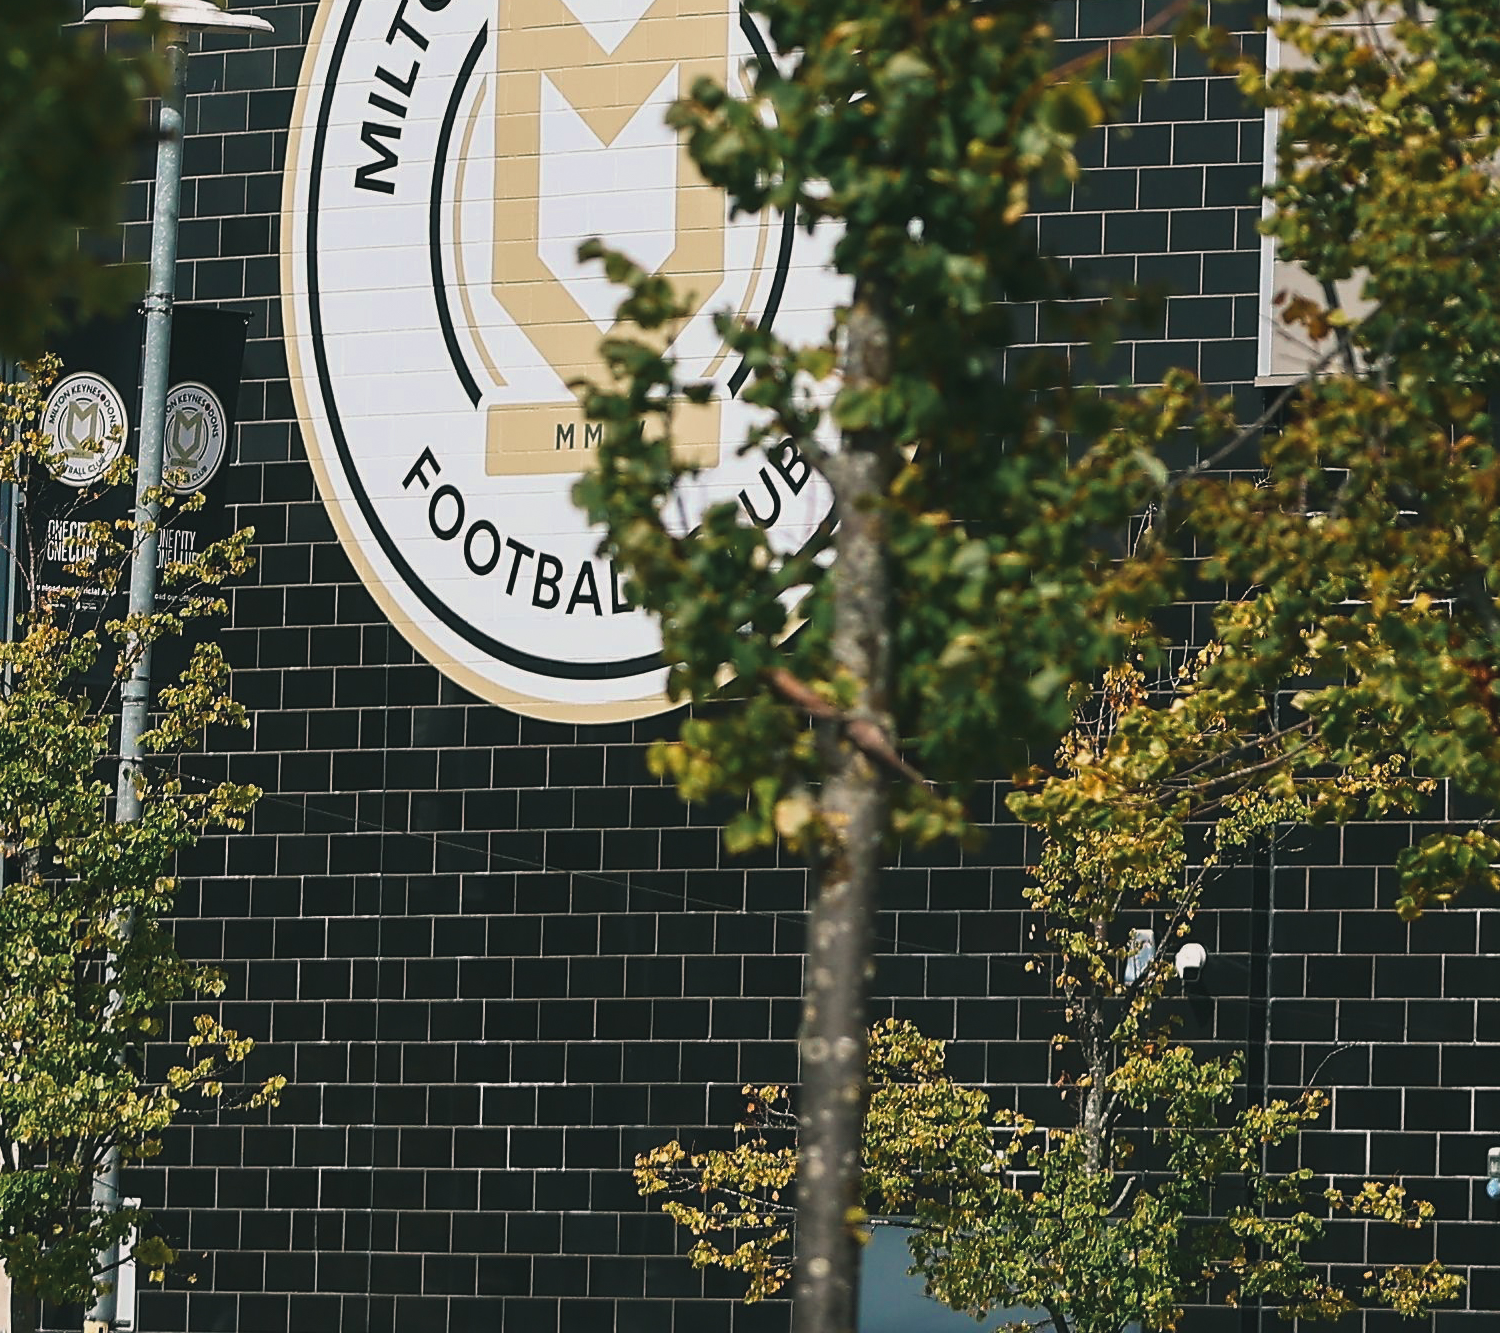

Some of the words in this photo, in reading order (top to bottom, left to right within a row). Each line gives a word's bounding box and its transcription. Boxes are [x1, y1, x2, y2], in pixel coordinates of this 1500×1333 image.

[48, 390, 71, 425] MILTON
[71, 383, 101, 398] KEYNES
[177, 393, 207, 406] KEYNES
[207, 408, 219, 438] DONS
[402, 446, 635, 617] FOOTBAL
